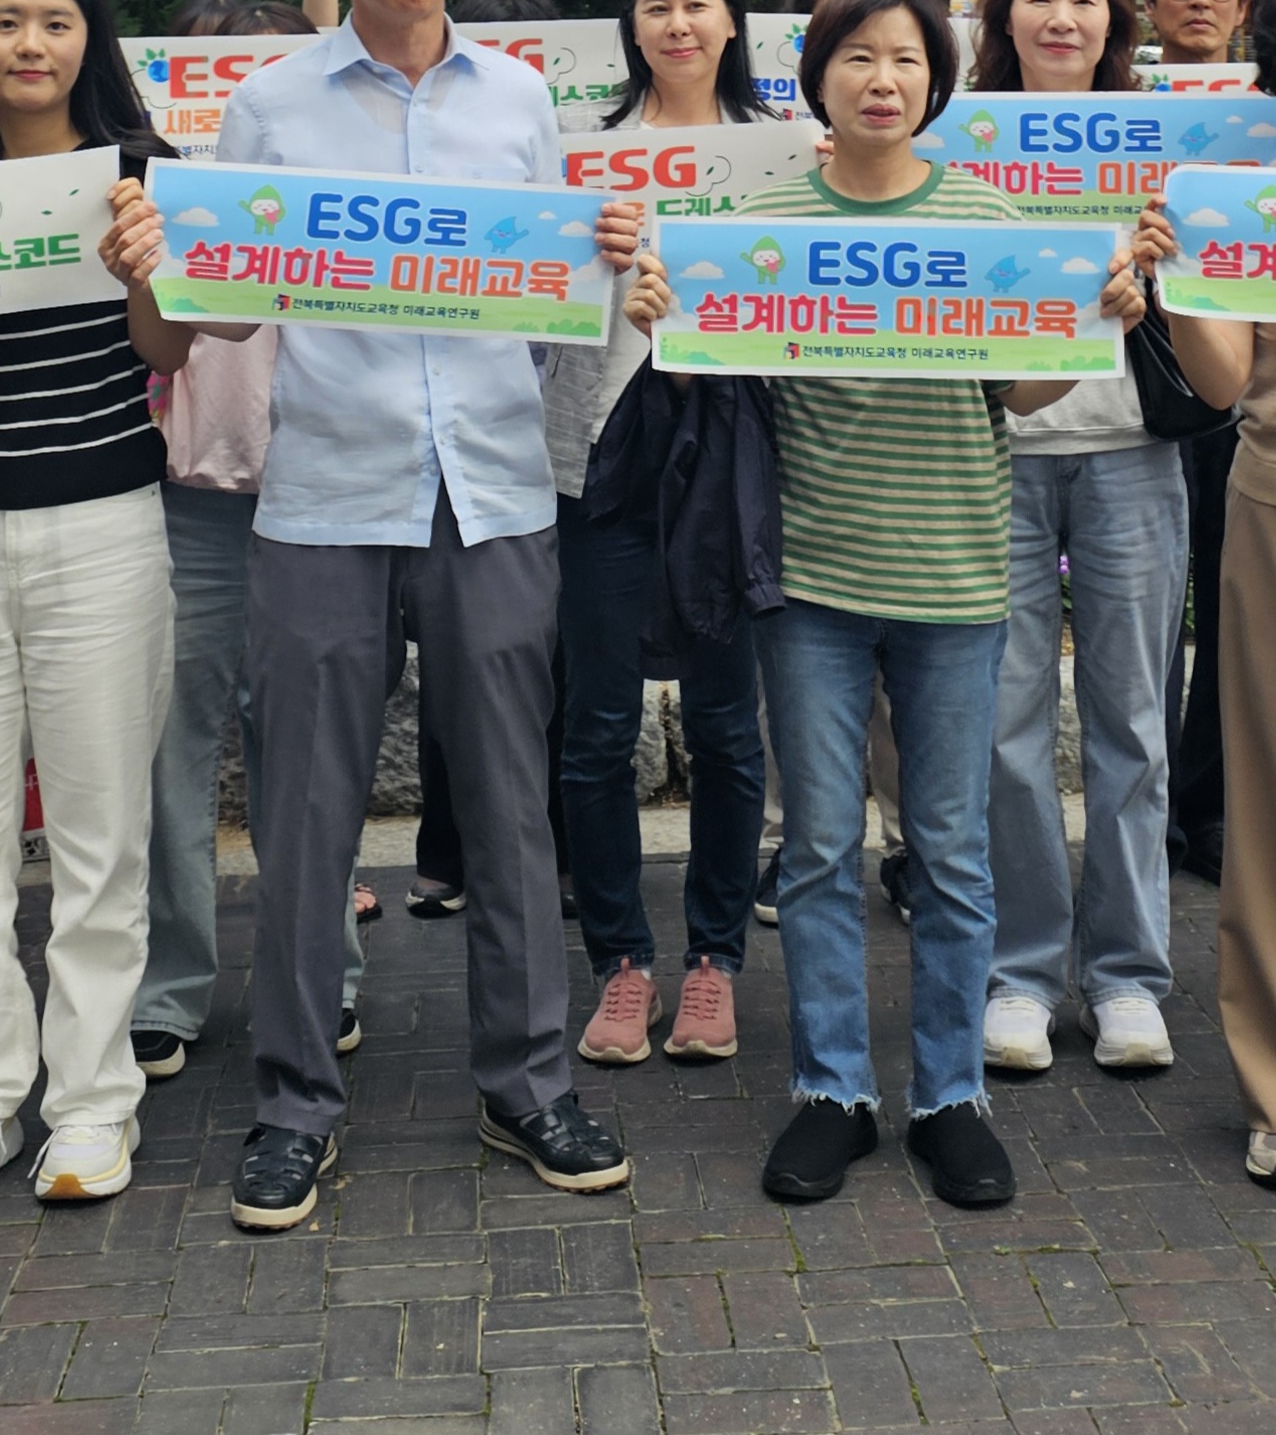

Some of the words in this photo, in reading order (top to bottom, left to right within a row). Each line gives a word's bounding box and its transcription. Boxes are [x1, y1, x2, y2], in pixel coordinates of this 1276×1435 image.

[169, 53, 289, 99] ES
[752, 77, 796, 102] 정의
[163, 108, 222, 135] 새로
[1019, 112, 1163, 153] ESG로
[566, 145, 697, 192] ESG
[947, 161, 1083, 196] 계하는
[306, 192, 467, 247] ESG로
[186, 242, 372, 289] 설계하는
[391, 255, 569, 301] 미래교육
[808, 241, 968, 288] ESG로
[292, 298, 399, 319] 전북특별자치도교육청
[403, 304, 480, 320] 미래교육연구원
[697, 293, 876, 334] 설계하는
[896, 297, 1076, 339] 미래교육
[802, 345, 907, 360] 전북특별자치도교육청
[911, 347, 989, 360] 미래교육연구원
